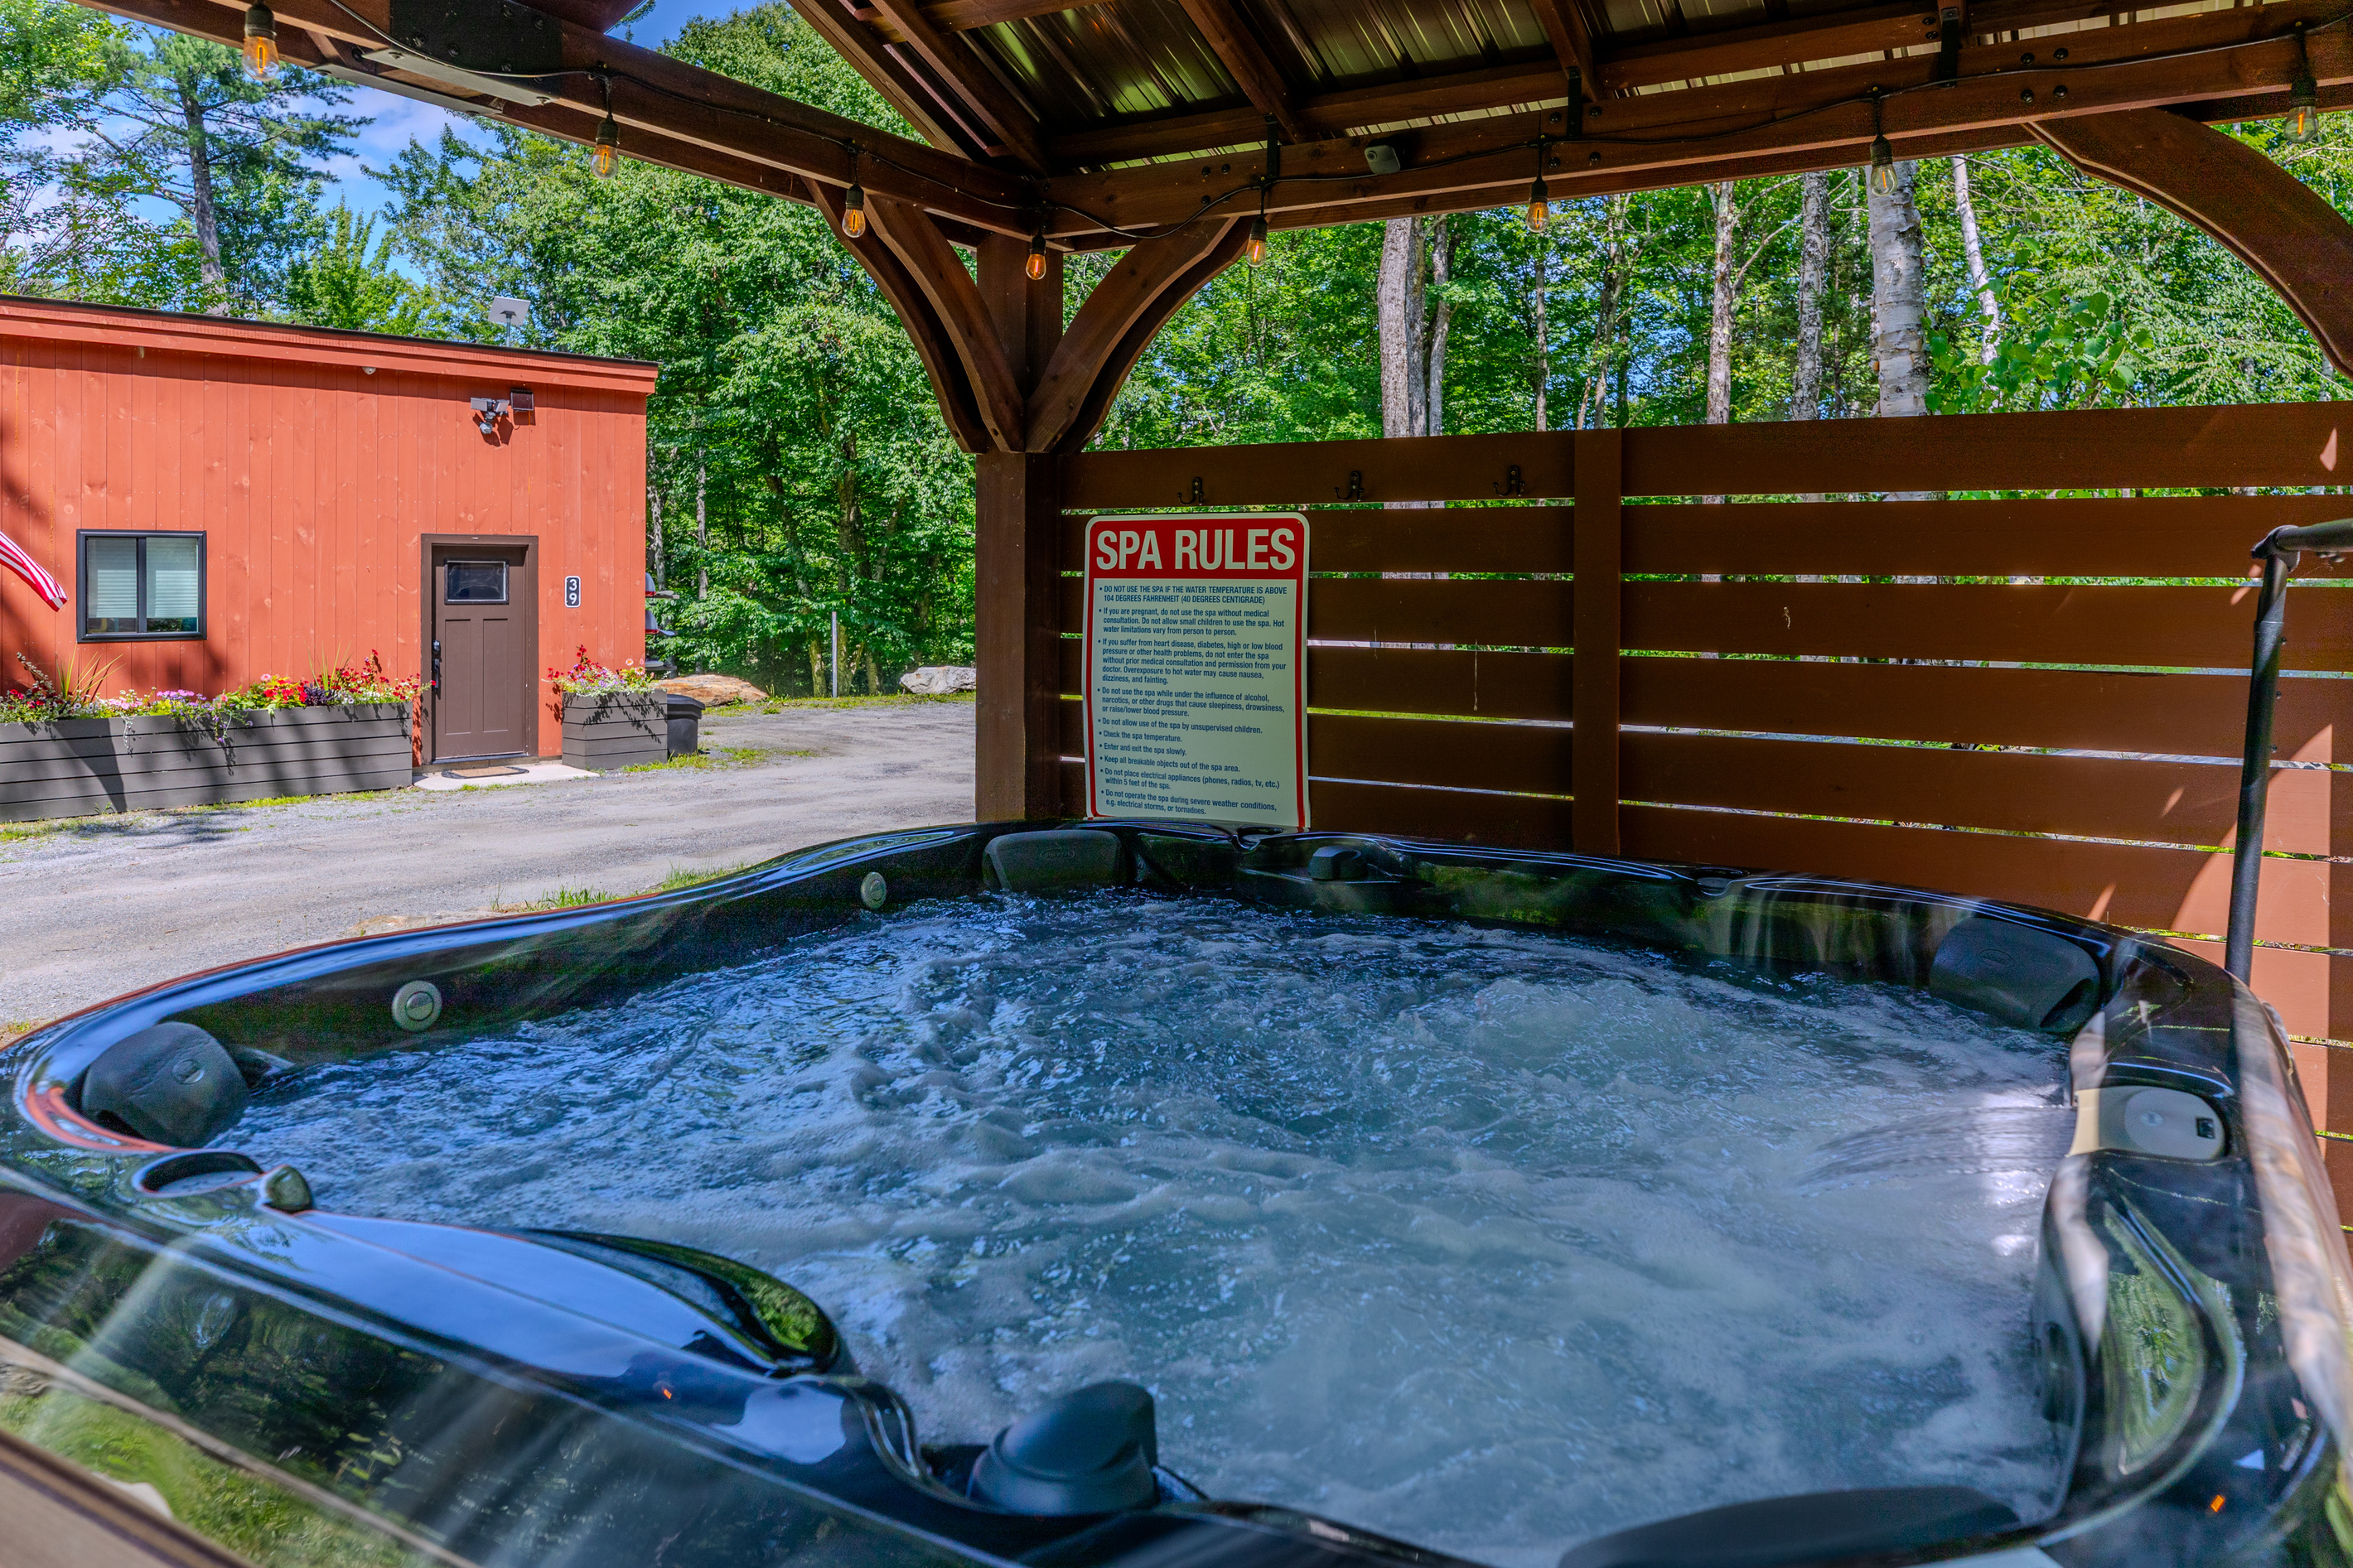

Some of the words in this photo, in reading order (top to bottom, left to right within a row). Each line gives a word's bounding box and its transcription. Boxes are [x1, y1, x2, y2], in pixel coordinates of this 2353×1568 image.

[1096, 530, 1162, 570] SPA
[1175, 528, 1296, 570] RULES
[569, 578, 577, 605] 39
[1104, 585, 1113, 593] DO
[1114, 585, 1125, 593] NOT
[1208, 586, 1255, 594] TEMPERATURE
[1264, 586, 1288, 595] ABOVE
[1104, 594, 1114, 602] 104
[1115, 594, 1142, 602] DEGREES
[1181, 595, 1191, 604] (40
[1192, 595, 1220, 603] DEGREES
[1222, 596, 1265, 605] CENTIGRADE)
[1109, 608, 1119, 616] you
[1131, 608, 1159, 616] pregnant,
[1217, 609, 1242, 617] without
[1197, 618, 1223, 626] children
[1245, 619, 1256, 627] the
[1121, 625, 1152, 634] limitations
[1167, 626, 1181, 634] from
[1182, 628, 1204, 636] person
[1213, 629, 1237, 637] person.
[1171, 639, 1196, 649] disease,
[1197, 640, 1225, 650] diabetes,
[1227, 641, 1241, 650] high
[1251, 642, 1263, 650] low
[1264, 642, 1283, 650] blood
[1137, 648, 1152, 656] other
[1173, 649, 1204, 659] problems,
[1245, 651, 1256, 659] the
[1257, 653, 1269, 661] spa
[1166, 659, 1203, 667] consultation
[1218, 660, 1253, 669] permission
[1254, 661, 1270, 669] from
[1123, 666, 1163, 675] Overexposure
[1203, 670, 1217, 678] may
[1239, 672, 1264, 680] nausea,
[1157, 689, 1173, 697] while
[1193, 691, 1204, 699] the
[1205, 692, 1234, 700] influence
[1235, 692, 1243, 701] of
[1244, 693, 1269, 703] alcohol,
[1102, 697, 1130, 705] narcotics,
[1156, 698, 1174, 708] drugs
[1175, 699, 1187, 707] that
[1208, 701, 1244, 712] sleepiness,
[1245, 702, 1285, 713] drowsiness,
[1109, 706, 1142, 714] raise/lower
[1143, 707, 1160, 715] blood
[1169, 722, 1181, 731] spa
[1181, 722, 1190, 731] by
[1191, 724, 1233, 732] unsupervised
[1234, 725, 1263, 734] children.
[1104, 730, 1120, 738] Check
[1143, 733, 1182, 742] temperature.
[1104, 755, 1119, 765] Keep
[1128, 756, 1156, 766] breakable
[1157, 760, 1179, 769] objects
[1199, 762, 1210, 770] the
[1124, 770, 1139, 778] place
[1140, 771, 1167, 779] electrical
[1167, 774, 1201, 783] appliances
[1202, 775, 1230, 786] (phones,
[1231, 778, 1254, 788] radios,
[1255, 779, 1263, 788] tv,
[1265, 780, 1280, 789] etc.)
[1105, 789, 1114, 797] Do
[1124, 792, 1146, 800] operate
[1170, 795, 1189, 805] during
[1212, 799, 1239, 808] weather
[1240, 802, 1277, 812] conditions,
